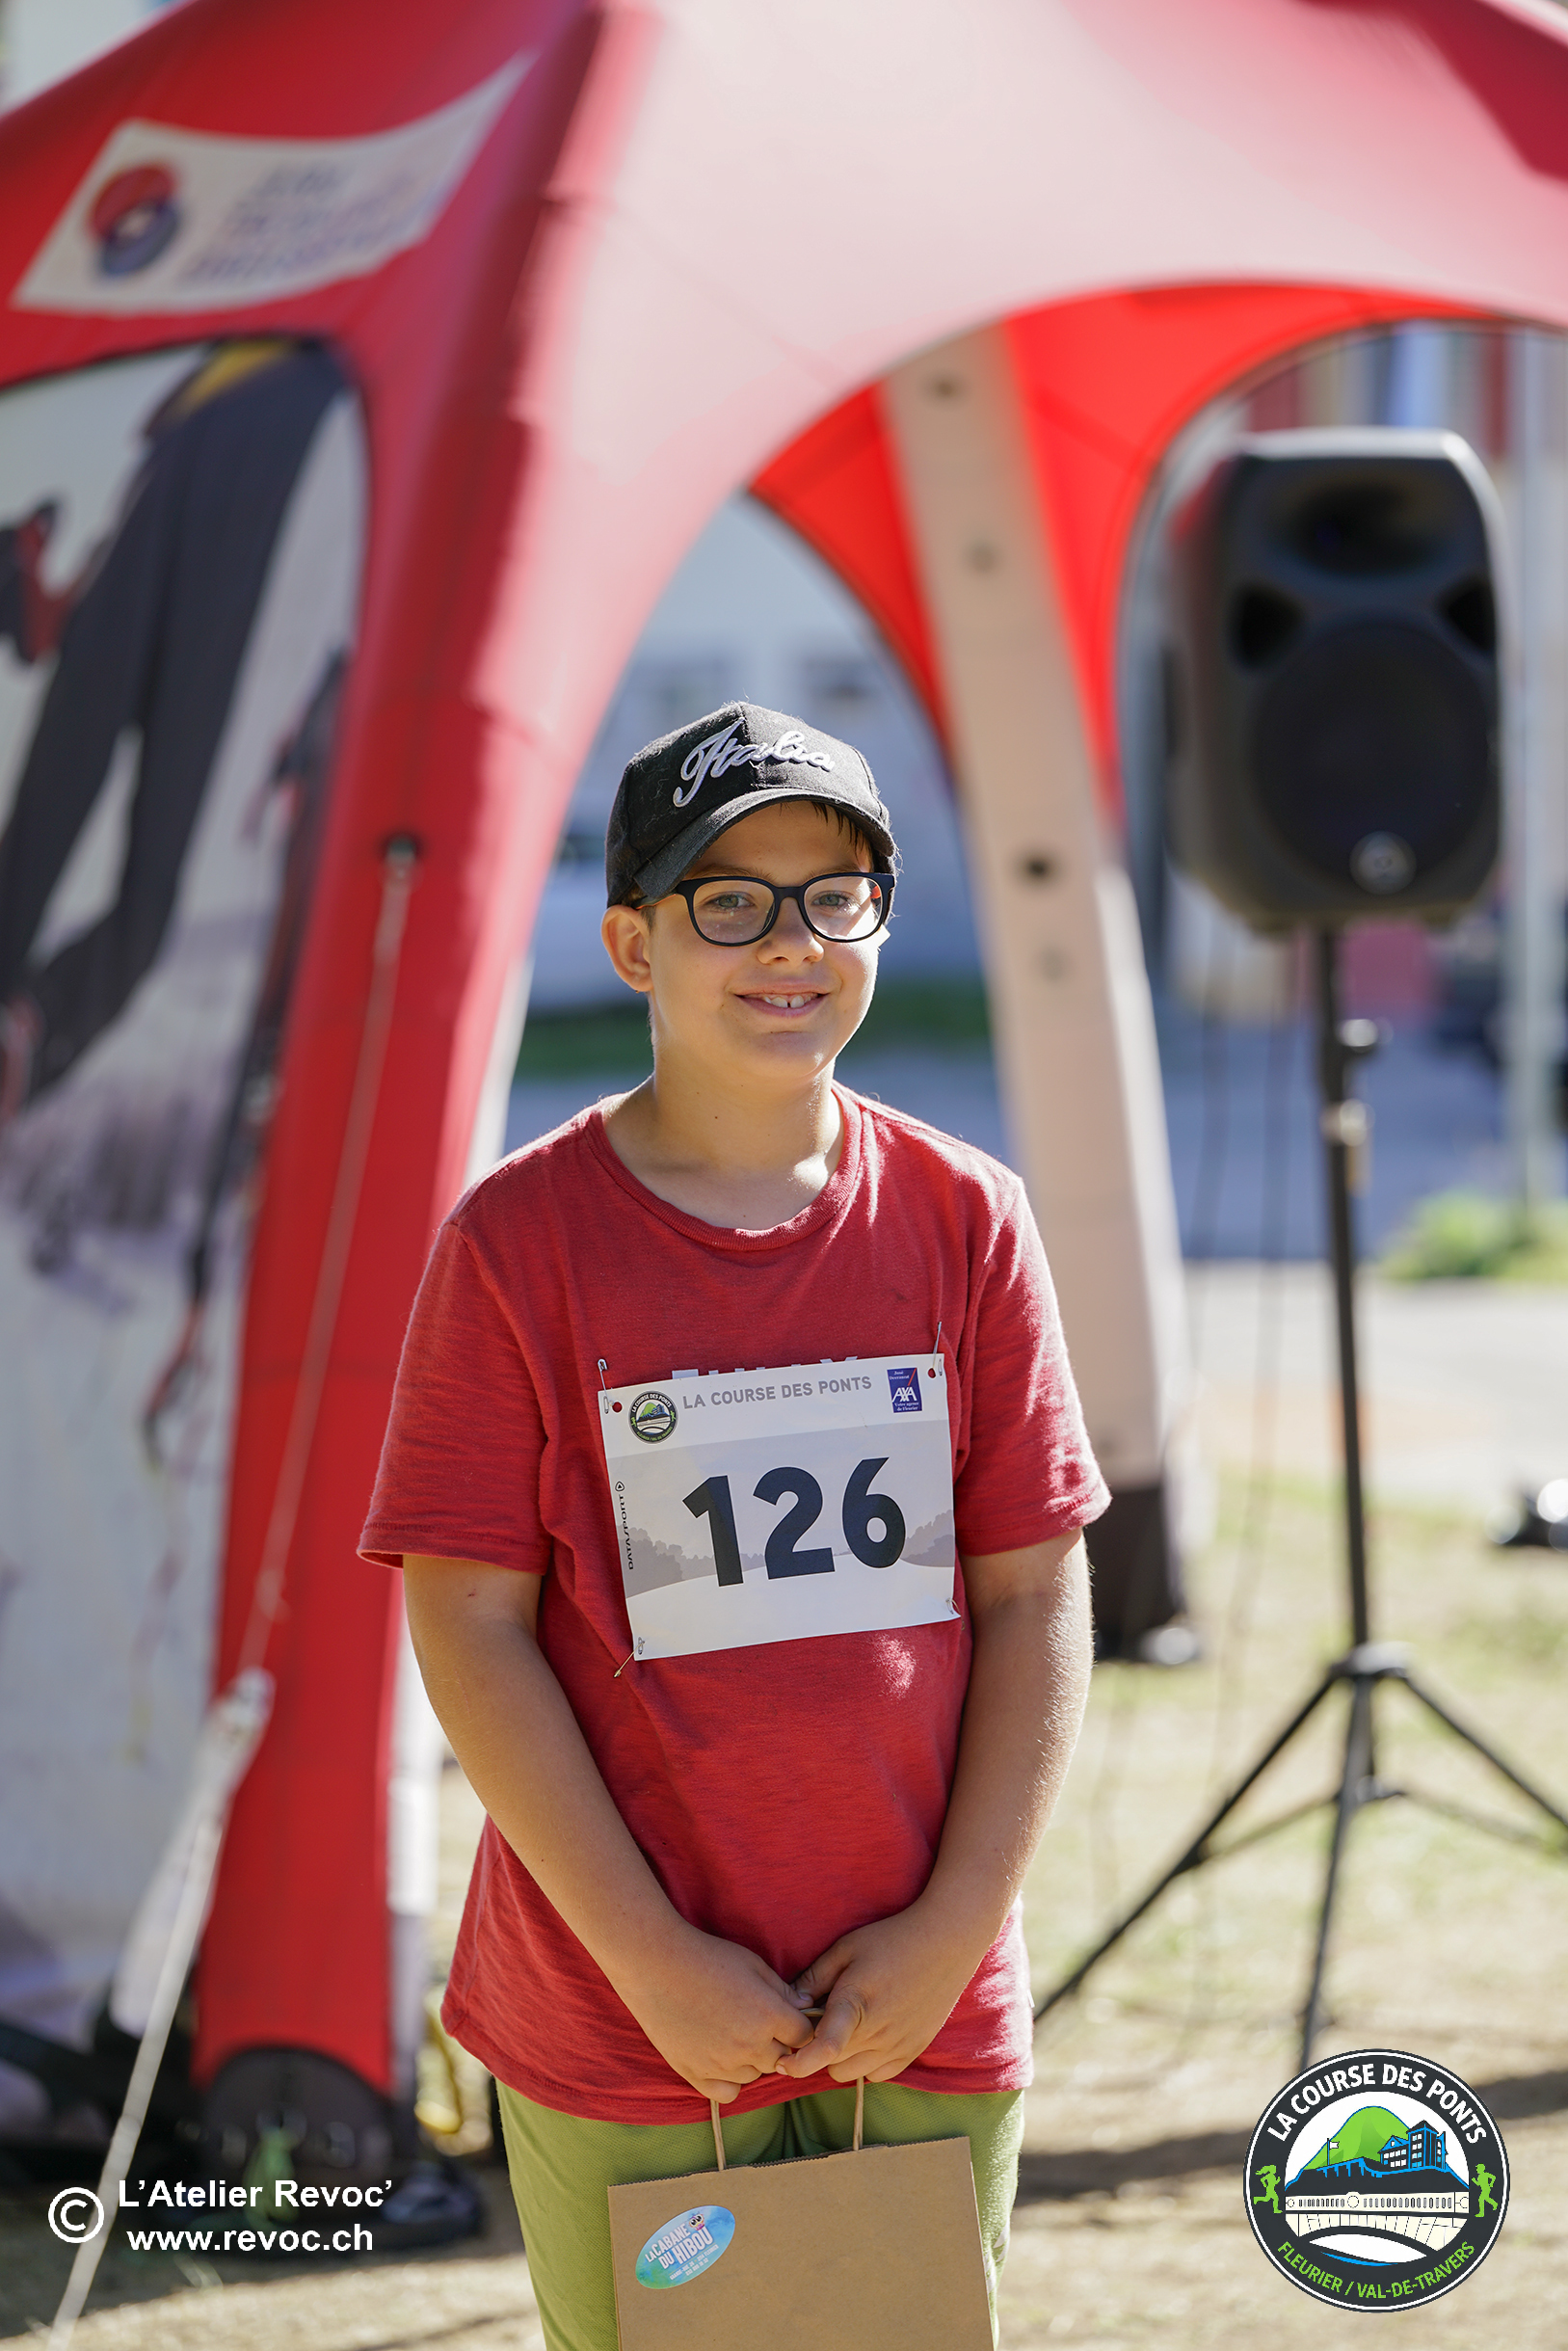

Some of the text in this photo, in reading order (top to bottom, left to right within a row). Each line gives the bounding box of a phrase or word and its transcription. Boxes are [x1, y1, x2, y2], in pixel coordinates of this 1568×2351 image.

[673, 717, 836, 808] Italia
[683, 1376, 872, 1409] LA COURSE DES PONTS
[891, 1386, 917, 1403] AXA
[618, 1494, 634, 1570] DATASPORT
[682, 1456, 907, 1588] 126
[645, 2223, 691, 2263] LA CABANE
[658, 2251, 675, 2270] DU
[671, 2226, 714, 2265] HIBOU
